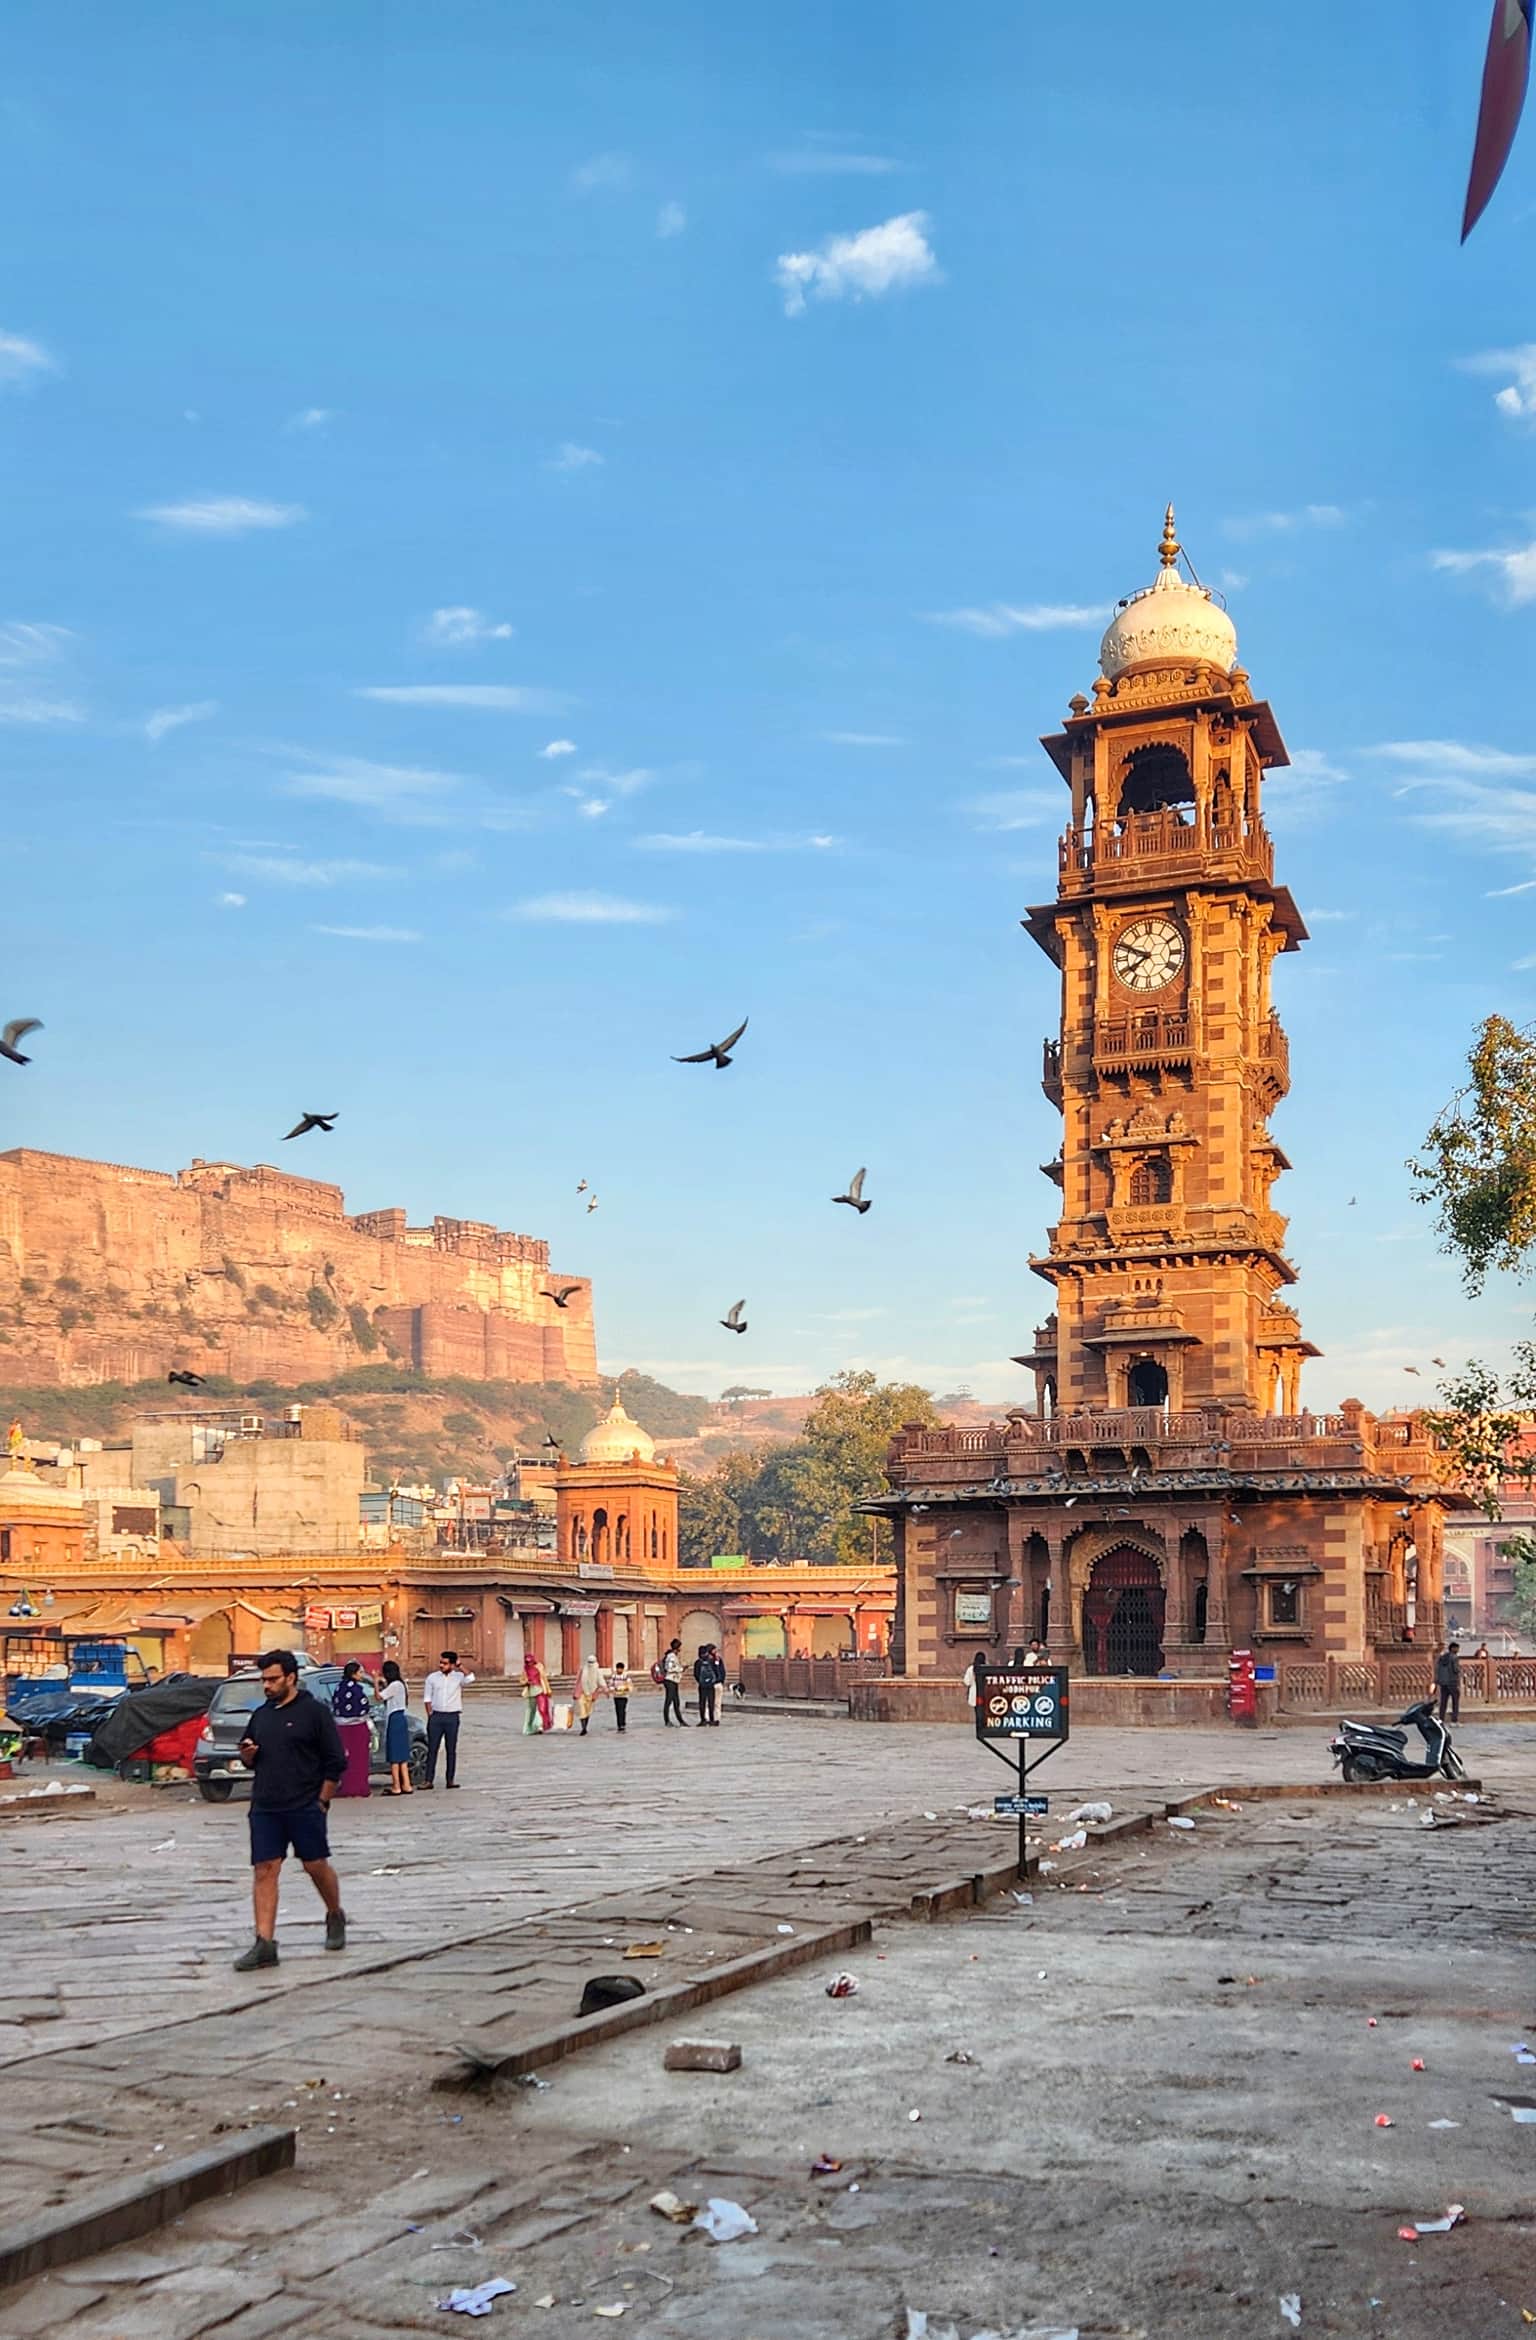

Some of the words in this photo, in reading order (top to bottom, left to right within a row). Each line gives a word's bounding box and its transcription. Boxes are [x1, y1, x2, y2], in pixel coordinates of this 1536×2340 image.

[985, 1675, 1026, 1685] TRAFFIC
[1027, 1675, 1057, 1685] POLICE
[986, 1716, 1002, 1728] NO
[1003, 1716, 1053, 1729] PARKING
